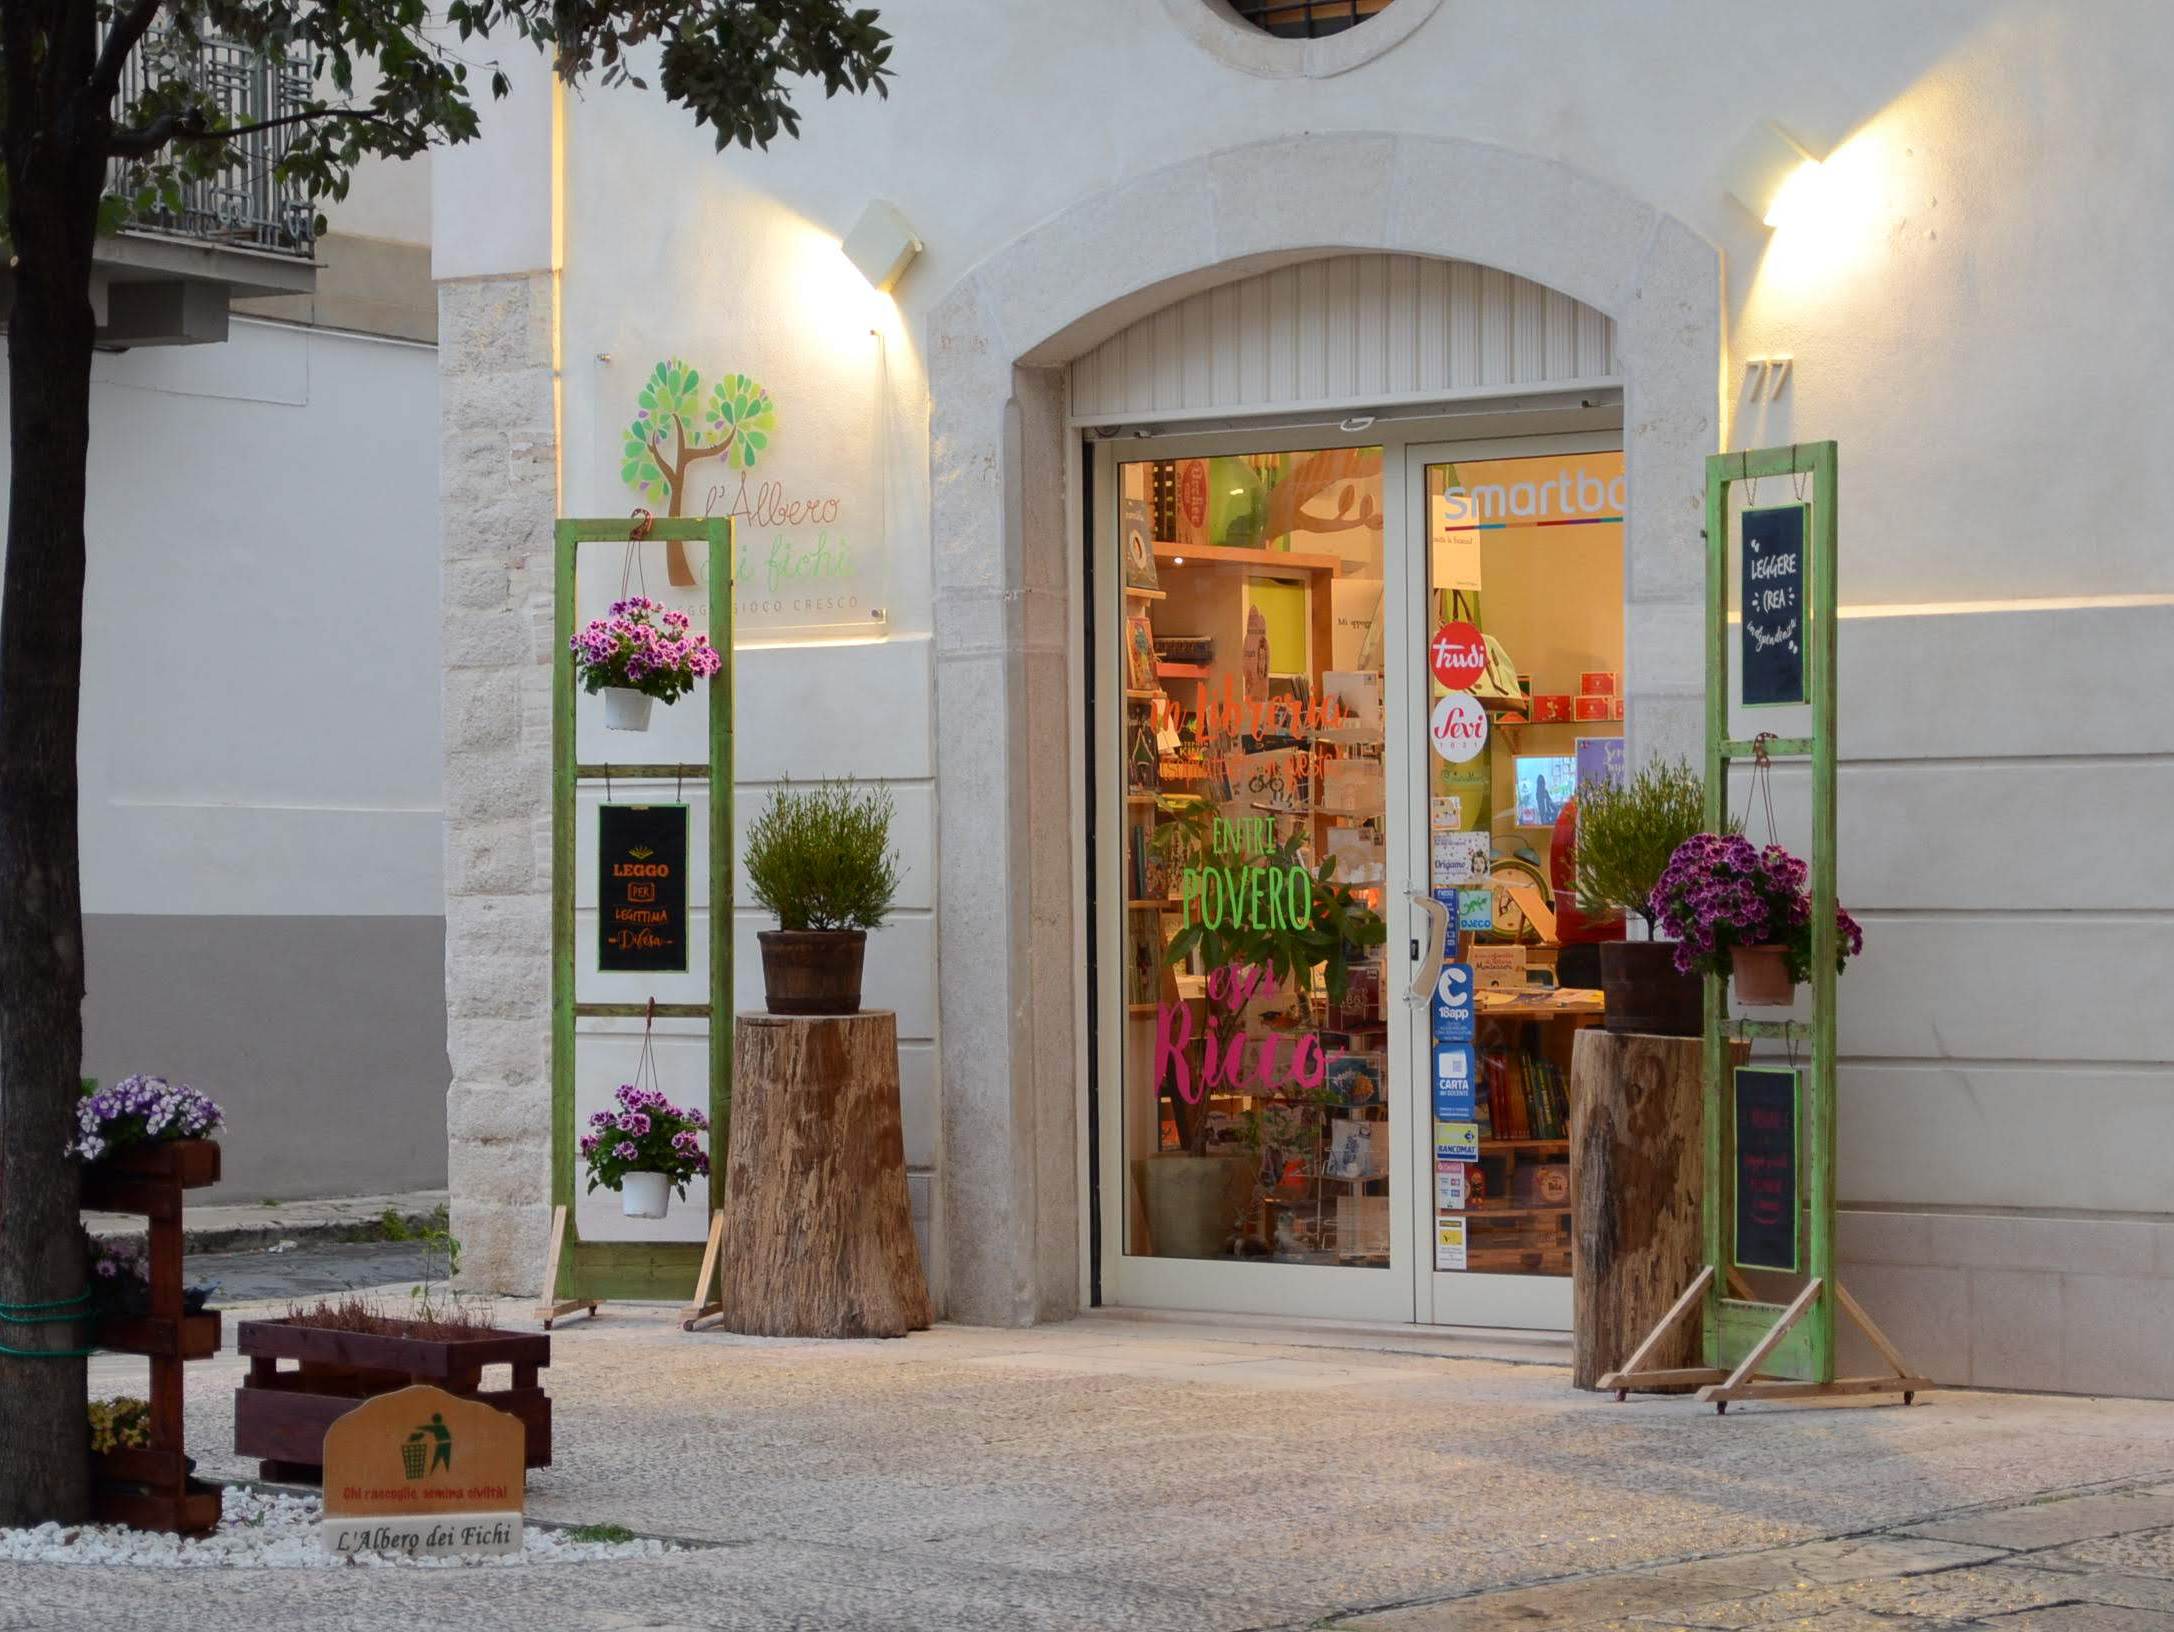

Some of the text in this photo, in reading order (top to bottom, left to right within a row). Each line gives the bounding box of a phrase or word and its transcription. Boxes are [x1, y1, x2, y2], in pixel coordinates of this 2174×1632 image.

[1746, 358, 1794, 401] 77
[1444, 466, 1625, 520] smartbo
[1750, 553, 1797, 580] LEGGERE
[733, 599, 784, 615] IOCO
[793, 596, 858, 612] CRESCO
[1434, 706, 1484, 739] Sevi
[1212, 815, 1276, 855] ENTRI
[613, 863, 670, 877] LEGGO
[632, 885, 650, 898] PER
[1182, 865, 1312, 932] POVERO
[615, 909, 668, 924] LEGITTIMA
[1460, 919, 1491, 928] DJECO
[1438, 1008, 1469, 1020] 18app
[1439, 1078, 1469, 1090] CARTA
[1438, 1144, 1476, 1154] BANCOMAT
[336, 1523, 511, 1552] L'Albero dei Fichi
